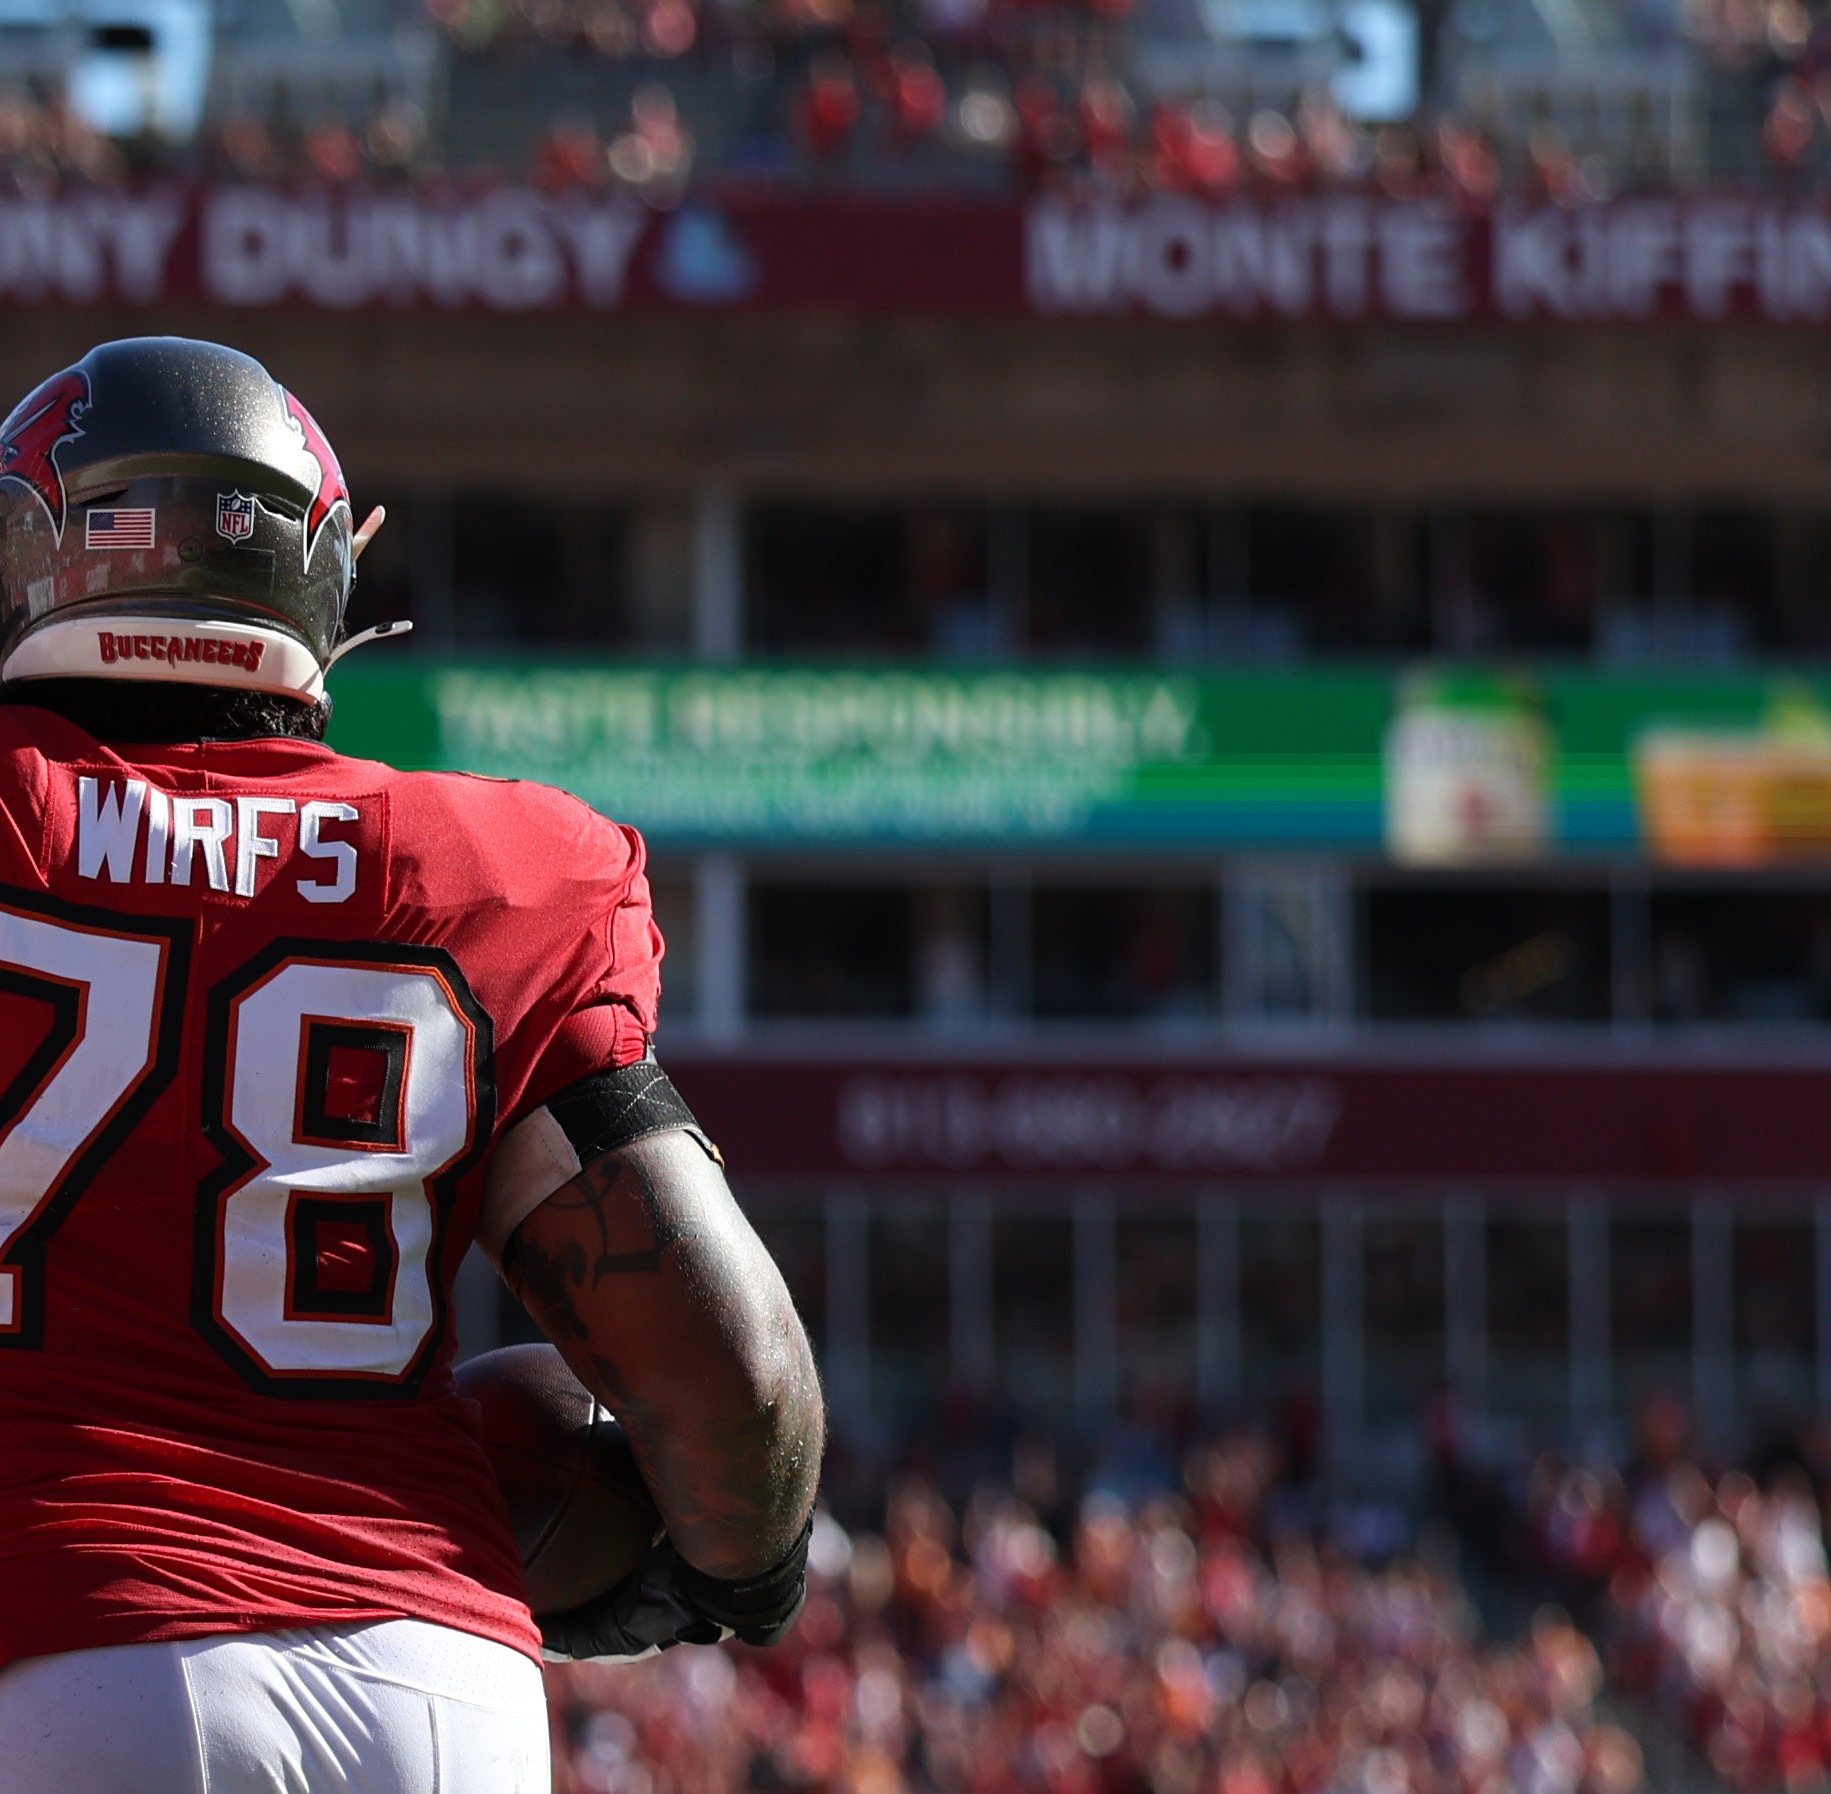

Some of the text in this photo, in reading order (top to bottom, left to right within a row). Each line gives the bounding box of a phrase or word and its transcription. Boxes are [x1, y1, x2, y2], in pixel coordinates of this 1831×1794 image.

[203, 198, 641, 296] DUNGY
[1027, 203, 1462, 316] MONTE
[221, 511, 249, 535] NFL
[97, 632, 266, 672] BUCCANEERS
[77, 777, 358, 903] WIRFS
